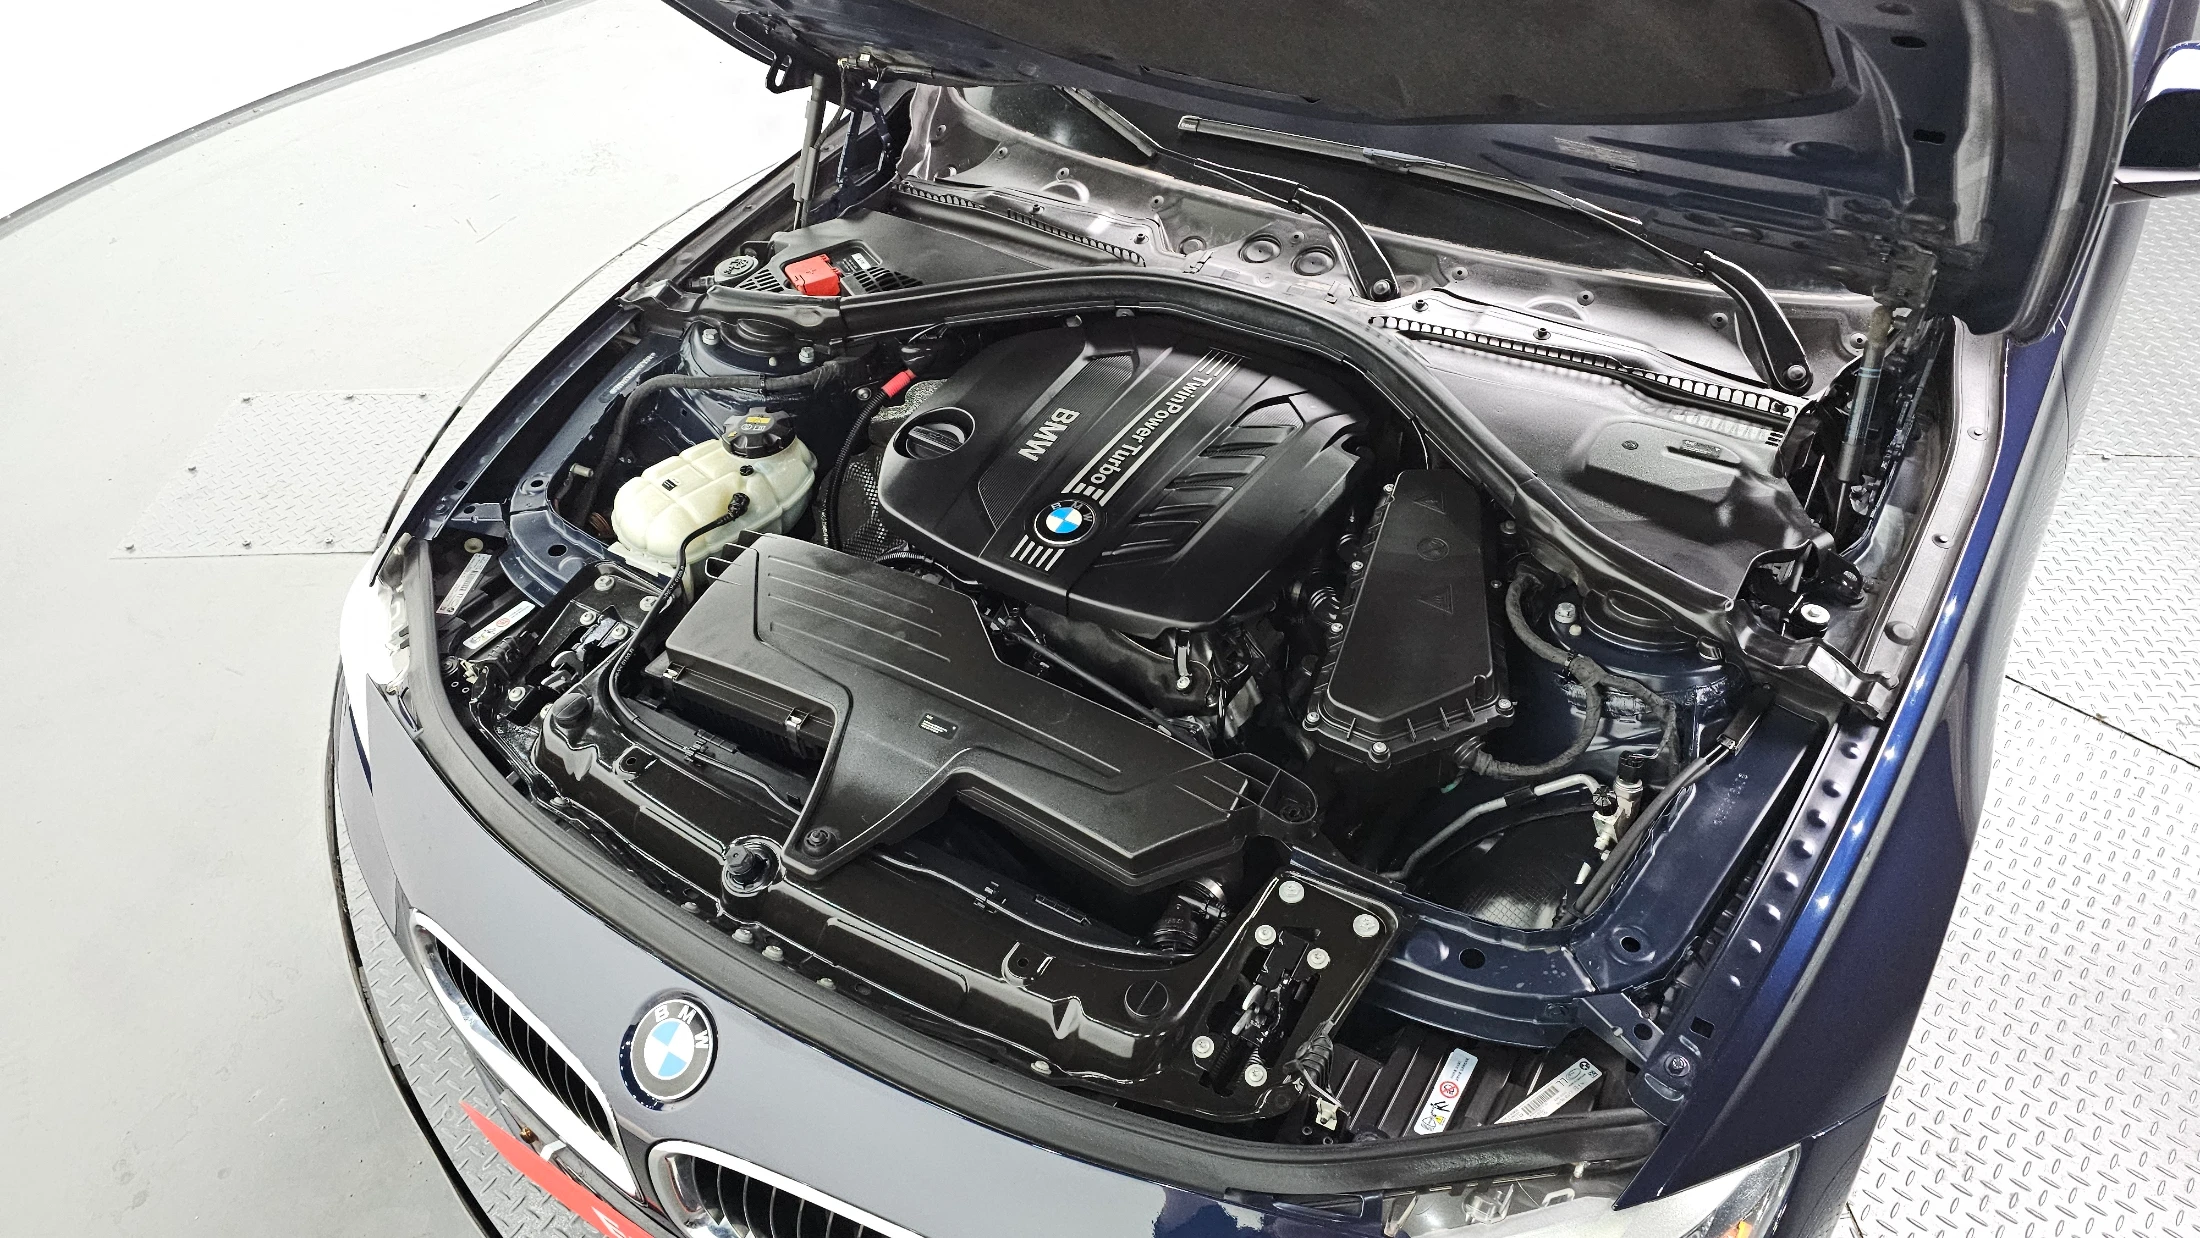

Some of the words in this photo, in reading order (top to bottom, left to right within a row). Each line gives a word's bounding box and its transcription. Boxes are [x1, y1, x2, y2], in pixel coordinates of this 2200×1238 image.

[1131, 376, 1213, 443] TwinPower
[1018, 408, 1081, 461] BMW
[1090, 443, 1144, 484] Turbo
[1051, 501, 1093, 522] BMW
[654, 1004, 709, 1049] BMW
